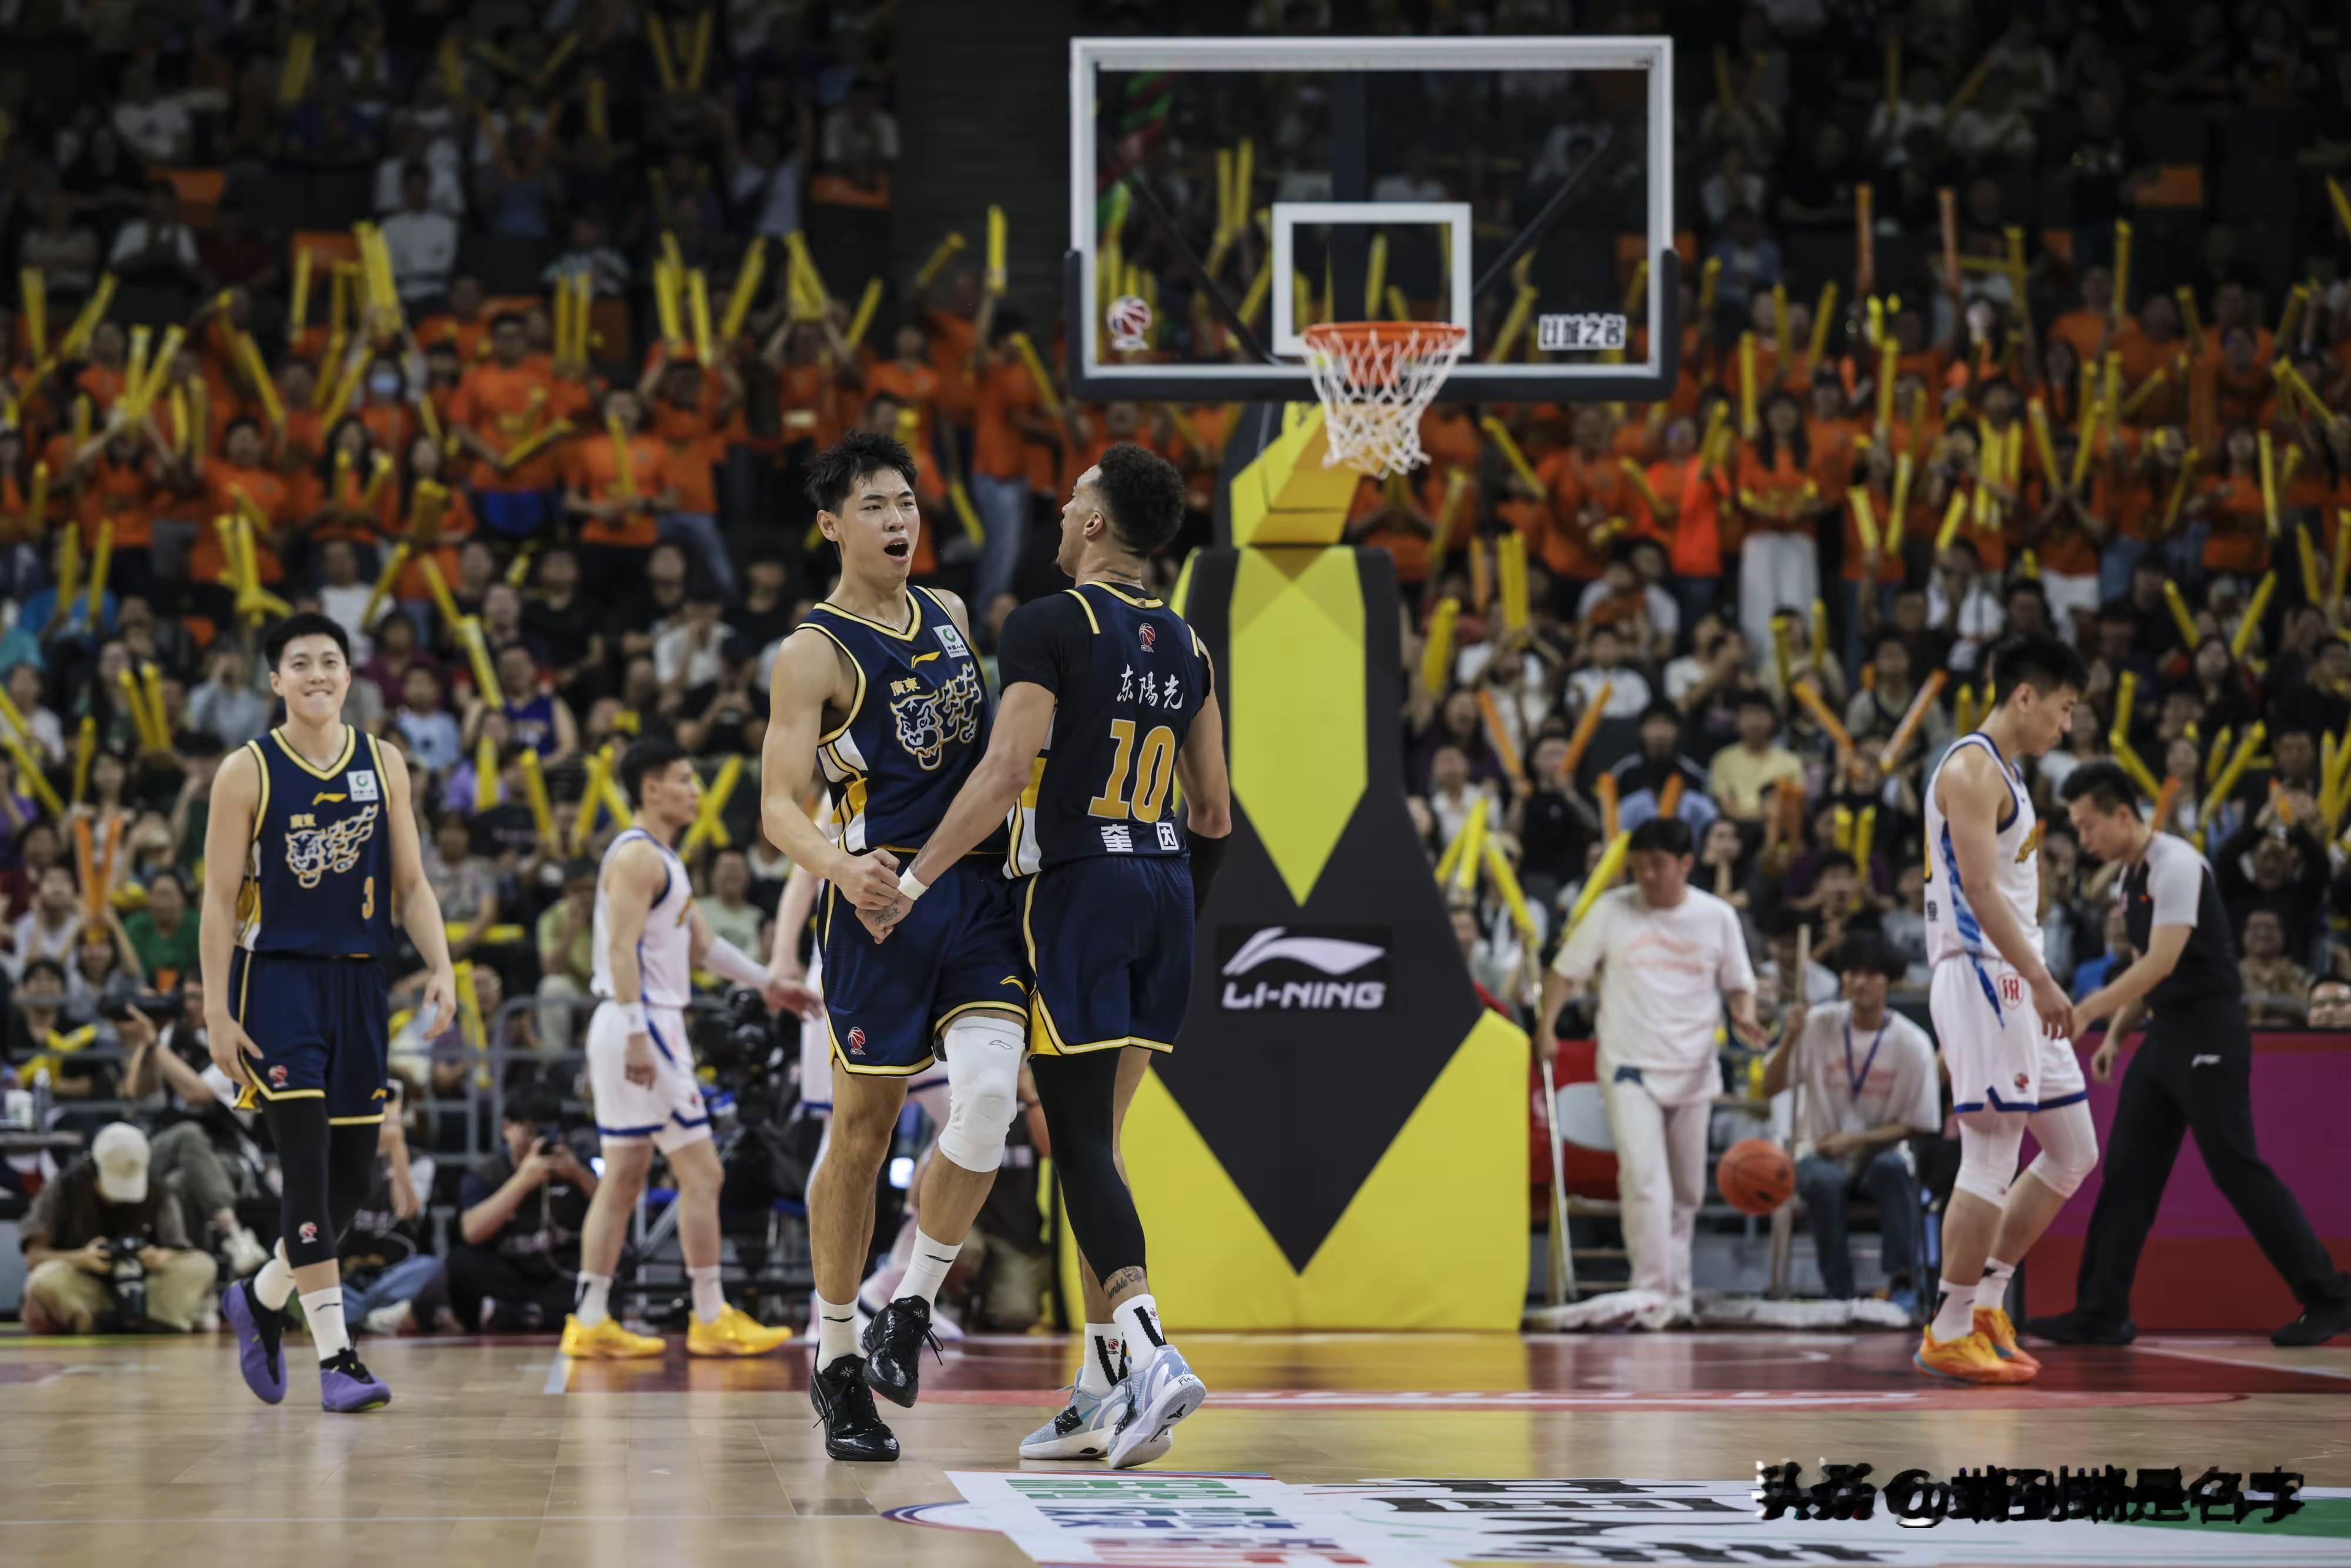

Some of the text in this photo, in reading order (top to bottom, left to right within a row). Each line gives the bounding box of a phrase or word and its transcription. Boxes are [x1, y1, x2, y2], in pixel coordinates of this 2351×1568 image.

[1087, 718, 1176, 823] 10
[362, 876, 374, 920] 3
[1222, 981, 1386, 1009] LI-NING
